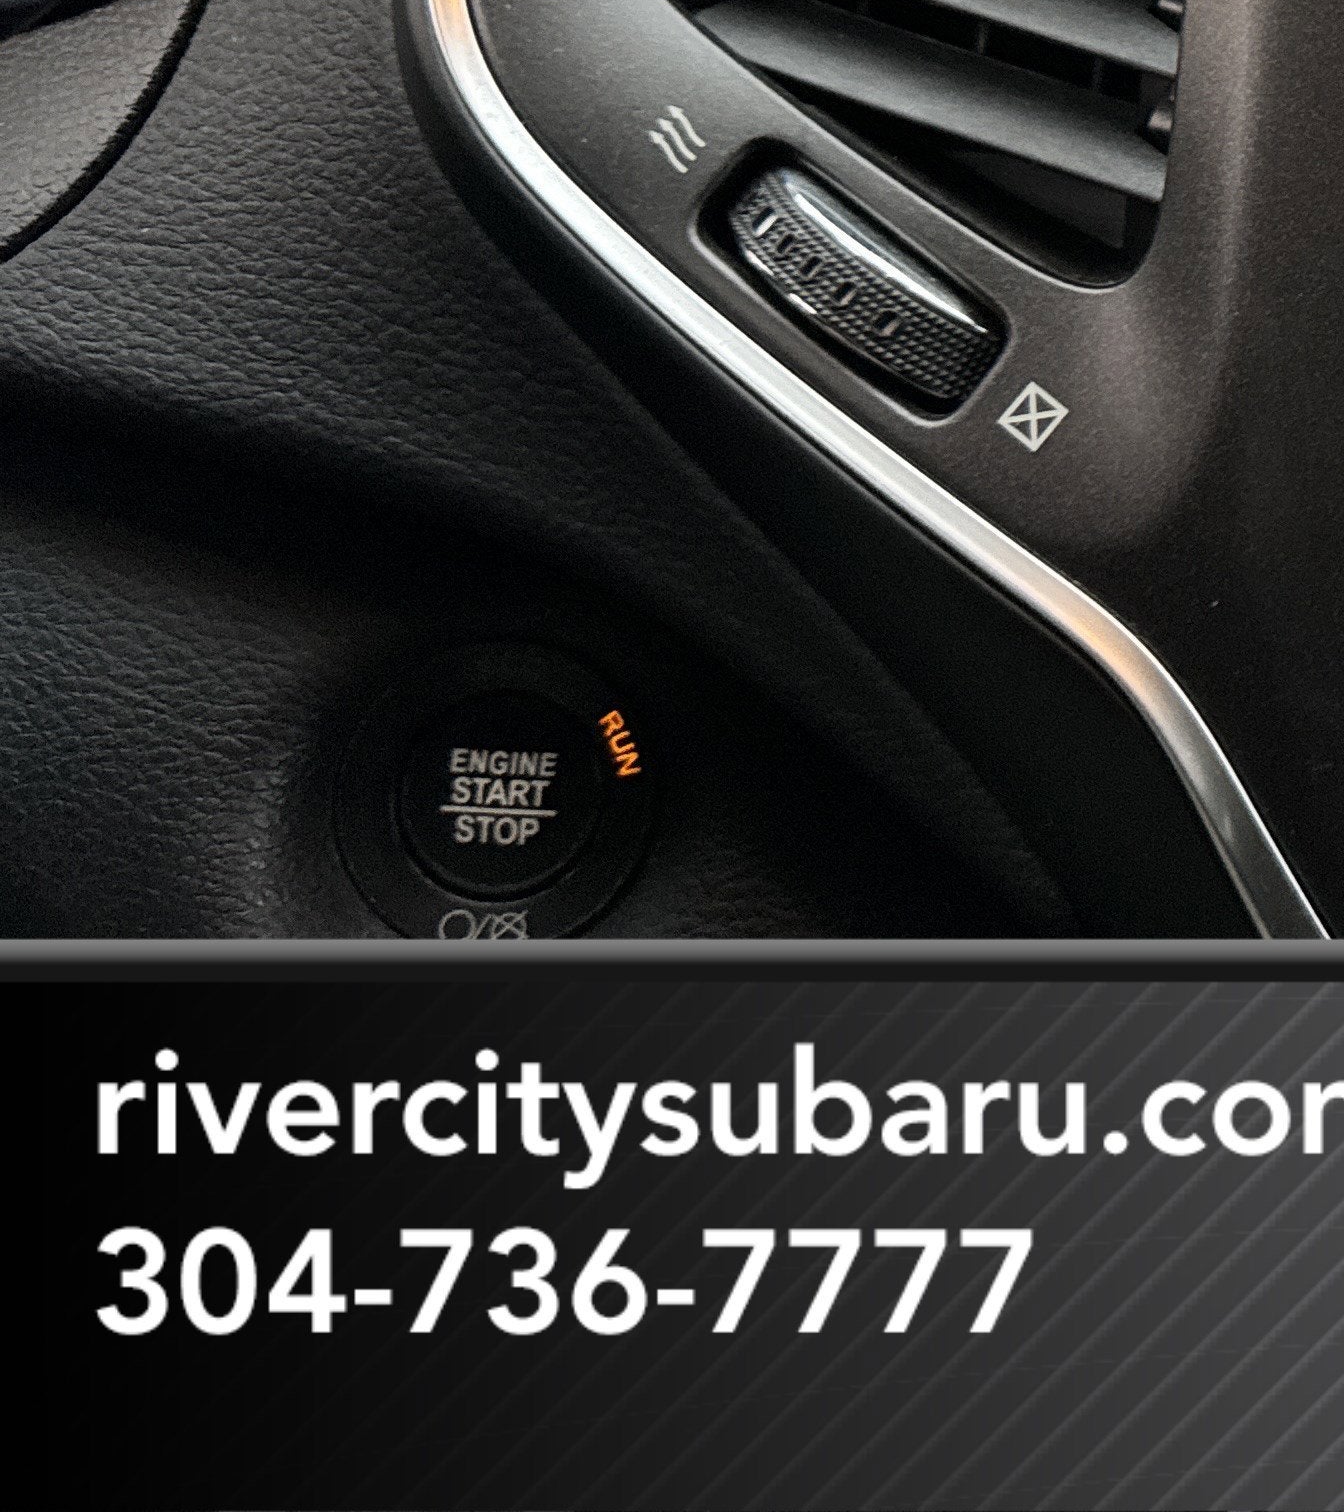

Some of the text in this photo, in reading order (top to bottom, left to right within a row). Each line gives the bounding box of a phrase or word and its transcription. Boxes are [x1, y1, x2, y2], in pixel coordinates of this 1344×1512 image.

[598, 709, 642, 778] RUN
[449, 748, 559, 778] ENGINE
[450, 776, 550, 808] START
[454, 815, 541, 846] STOP
